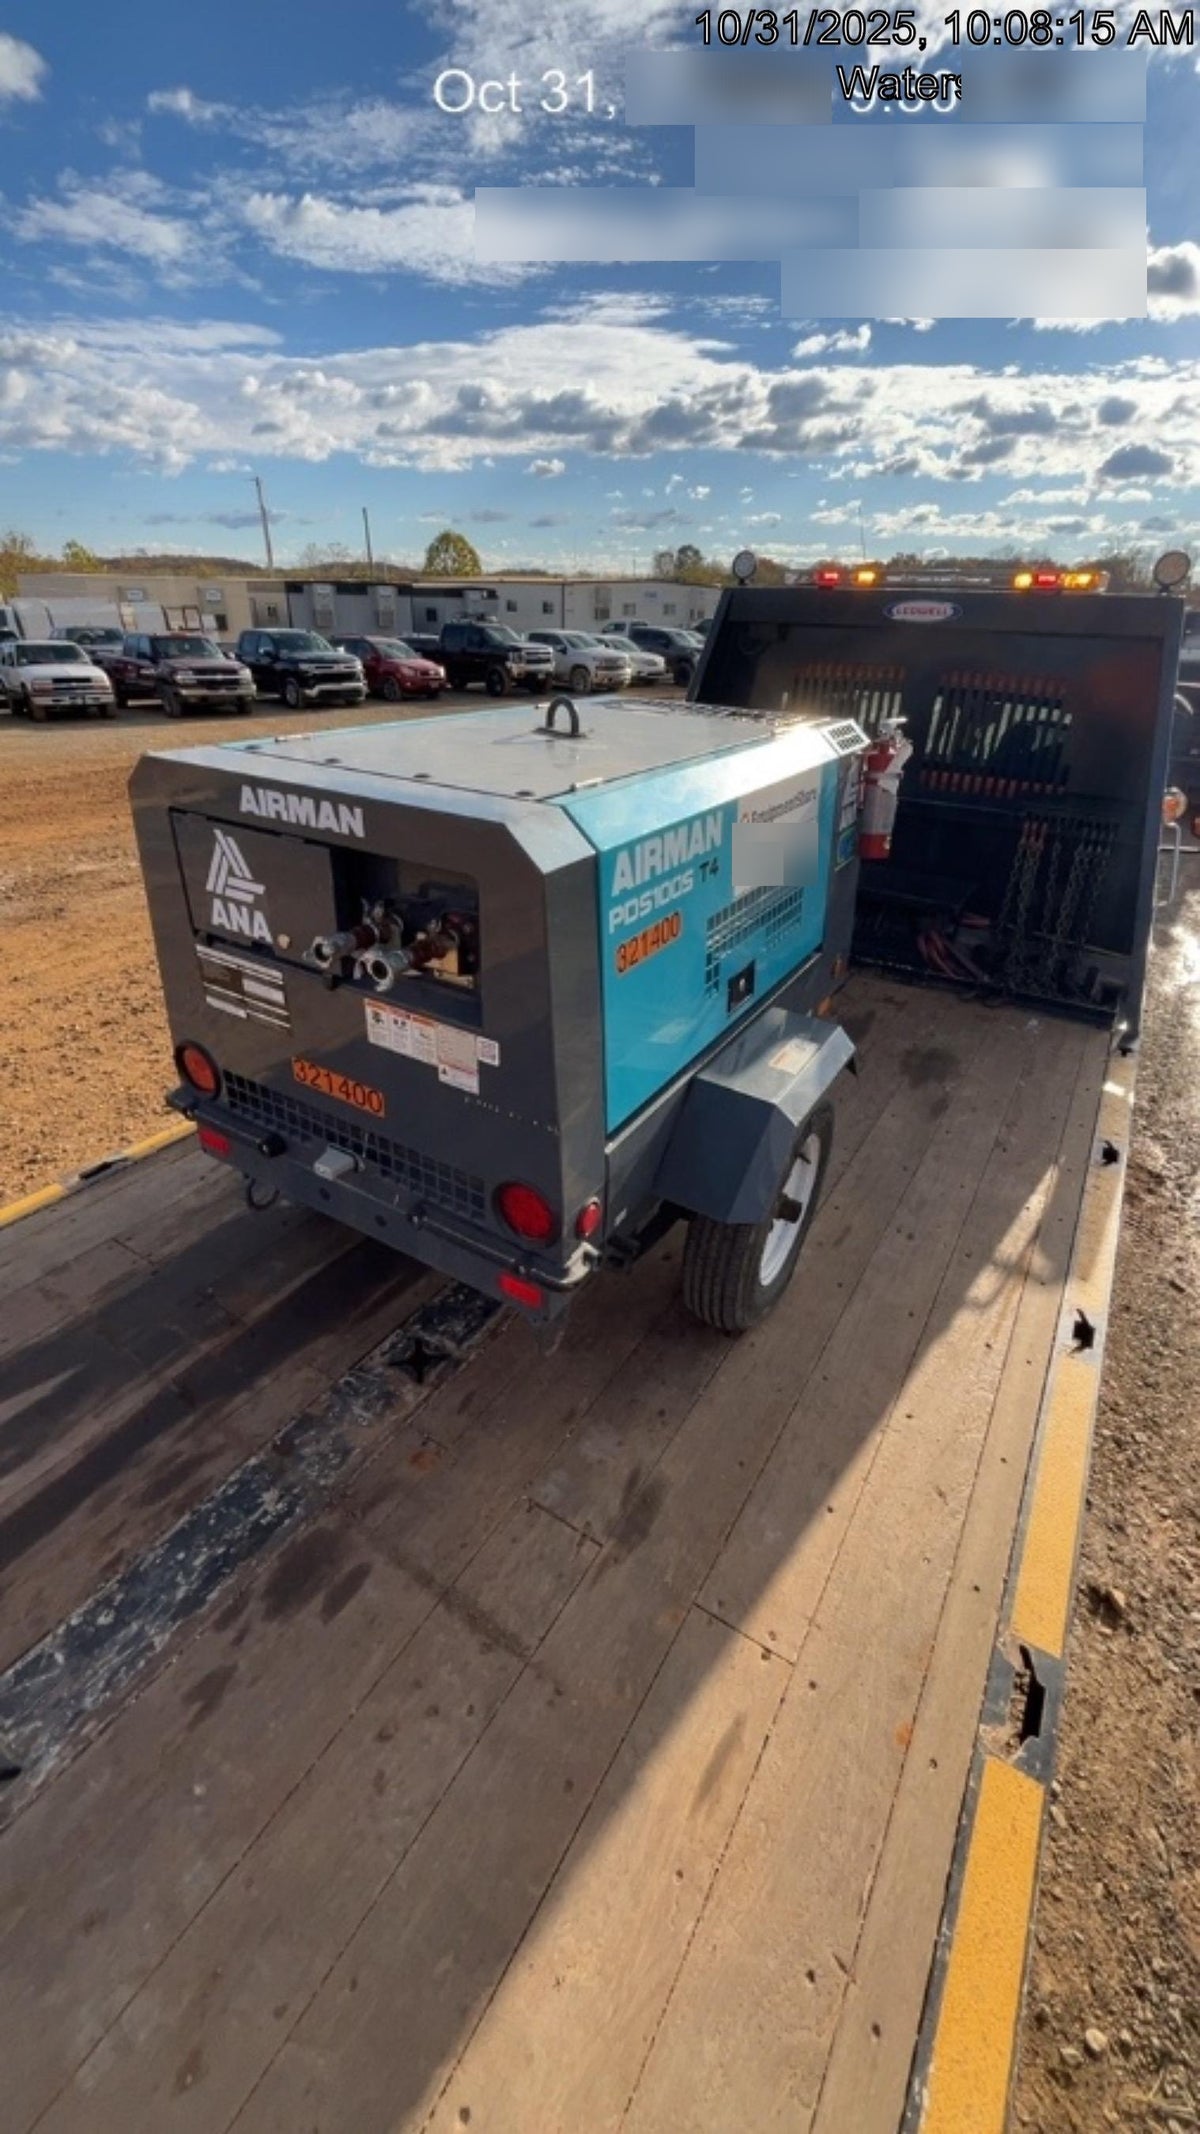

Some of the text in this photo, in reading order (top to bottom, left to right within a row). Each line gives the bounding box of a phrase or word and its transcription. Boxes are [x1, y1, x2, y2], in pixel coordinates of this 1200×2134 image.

[240, 784, 365, 838] AIRMAN
[611, 810, 723, 898] AIRMAN
[699, 857, 719, 883] T4
[211, 899, 273, 944] ANA
[616, 911, 680, 974] 321400
[293, 1058, 383, 1114] 321400
